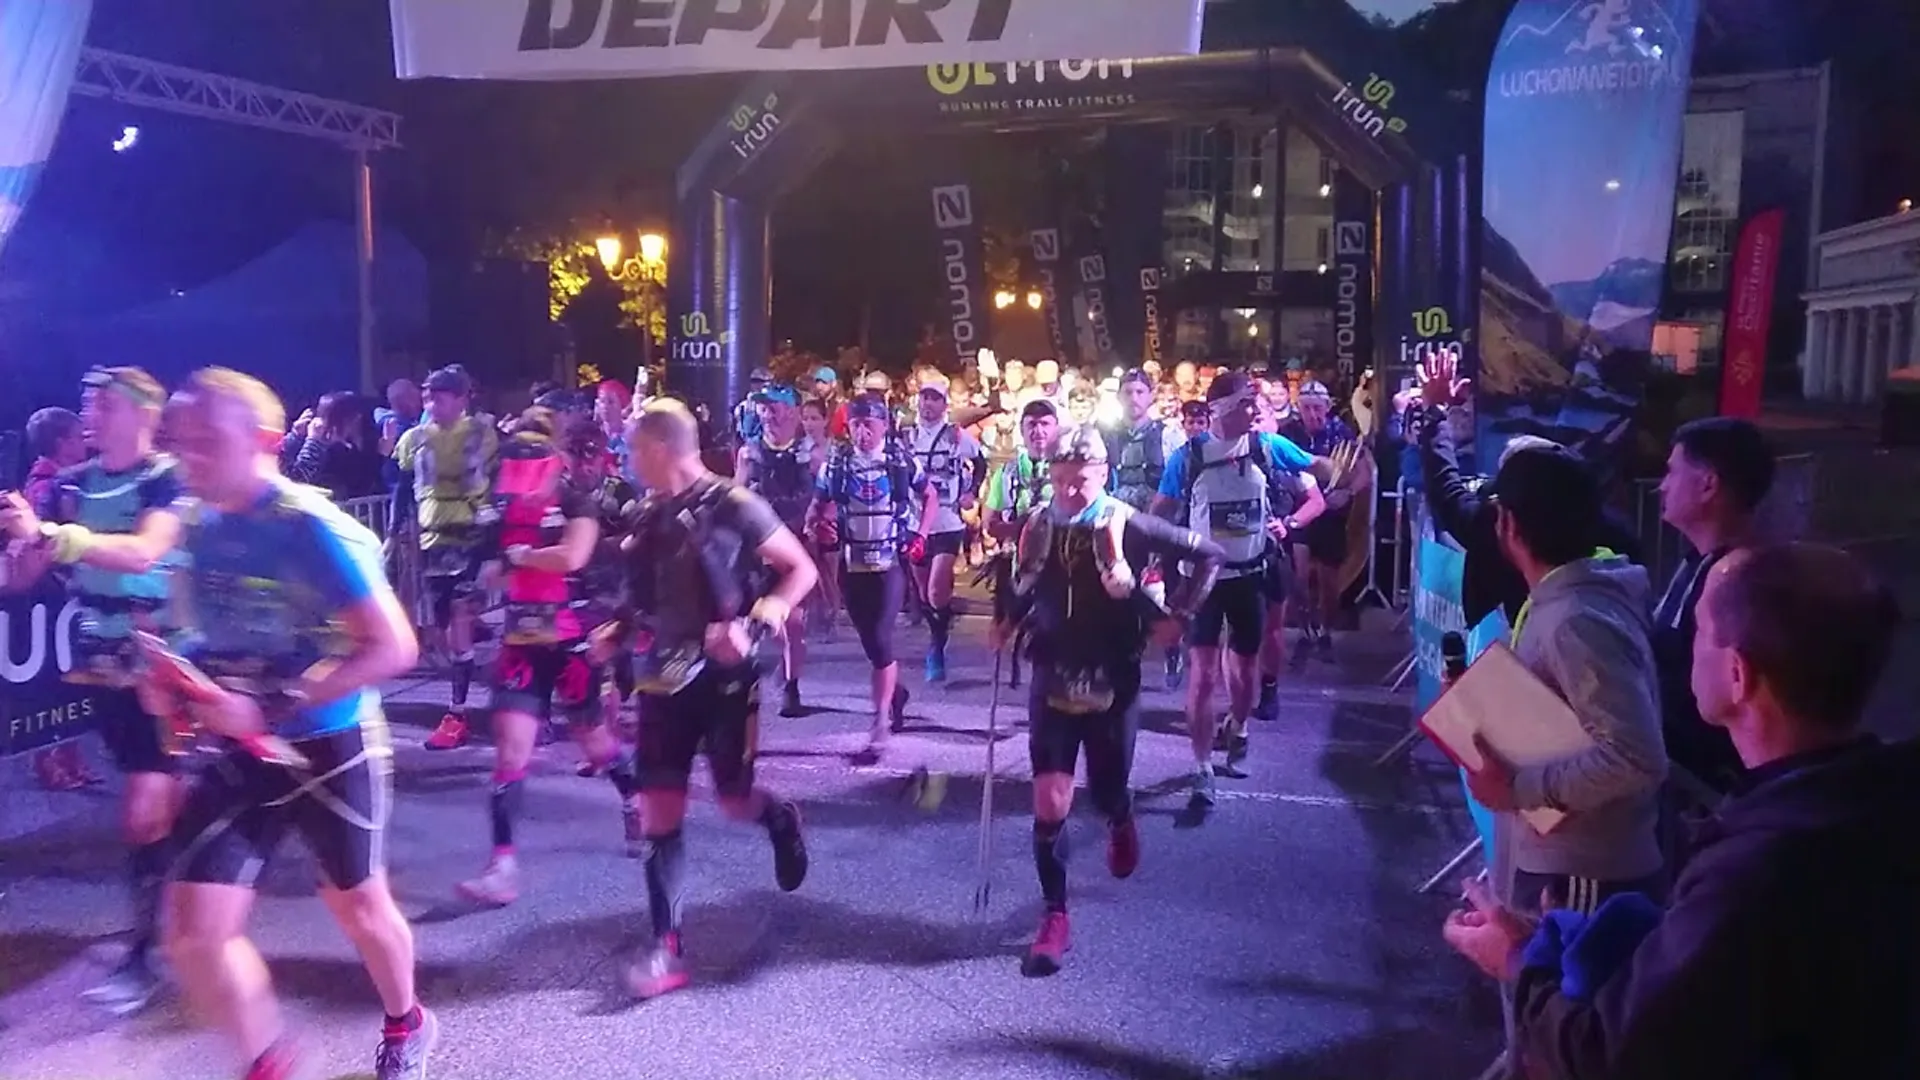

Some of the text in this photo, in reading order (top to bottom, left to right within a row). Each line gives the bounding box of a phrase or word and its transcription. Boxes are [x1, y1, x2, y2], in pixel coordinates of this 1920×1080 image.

[939, 94, 1136, 112] RUNNING TRAIL FITNESS
[1333, 81, 1385, 137] i-run
[730, 112, 781, 158] i-run
[672, 336, 721, 360] i-run
